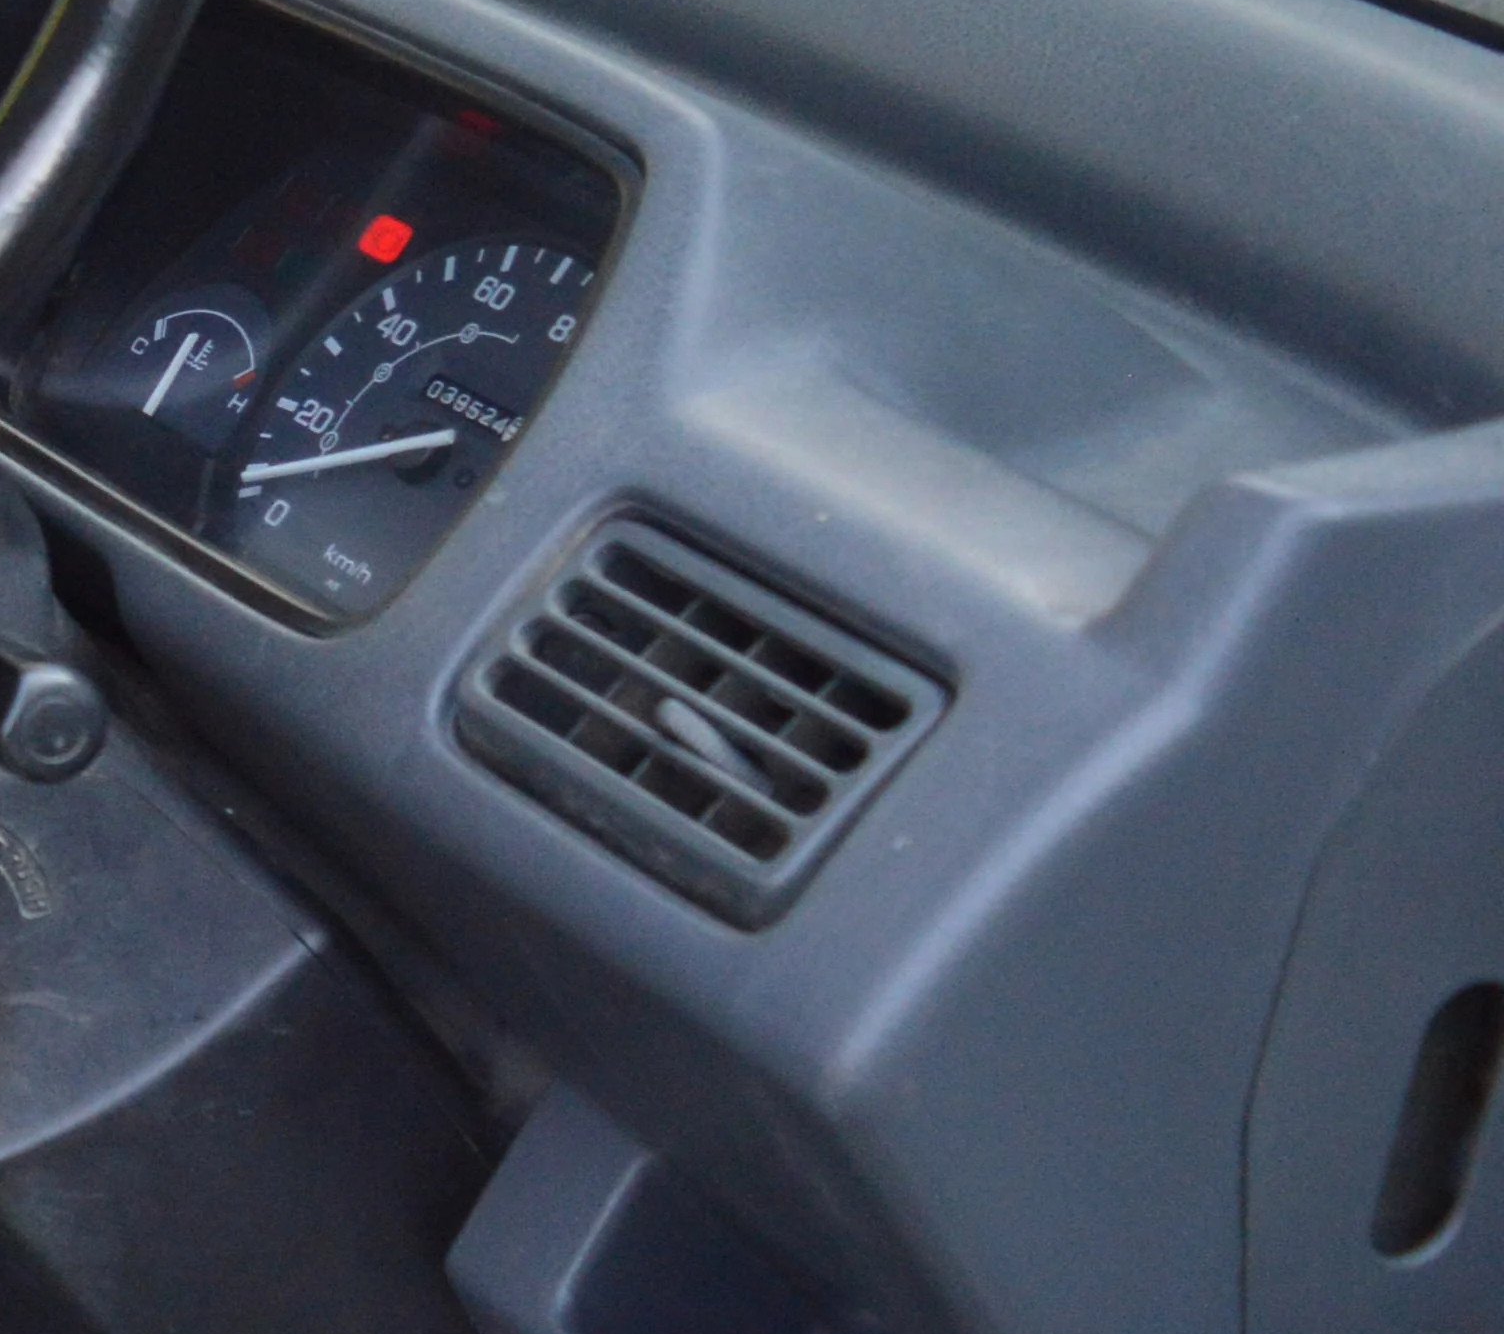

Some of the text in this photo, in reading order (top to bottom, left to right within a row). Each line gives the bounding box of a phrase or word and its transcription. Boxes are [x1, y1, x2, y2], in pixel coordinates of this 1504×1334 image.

[473, 276, 516, 310] 60
[376, 313, 418, 347] 40
[548, 314, 576, 343] 8
[130, 336, 149, 355] C
[227, 393, 249, 414] H
[294, 399, 334, 434] 20
[264, 499, 289, 527] 0
[323, 543, 372, 585] km/h
